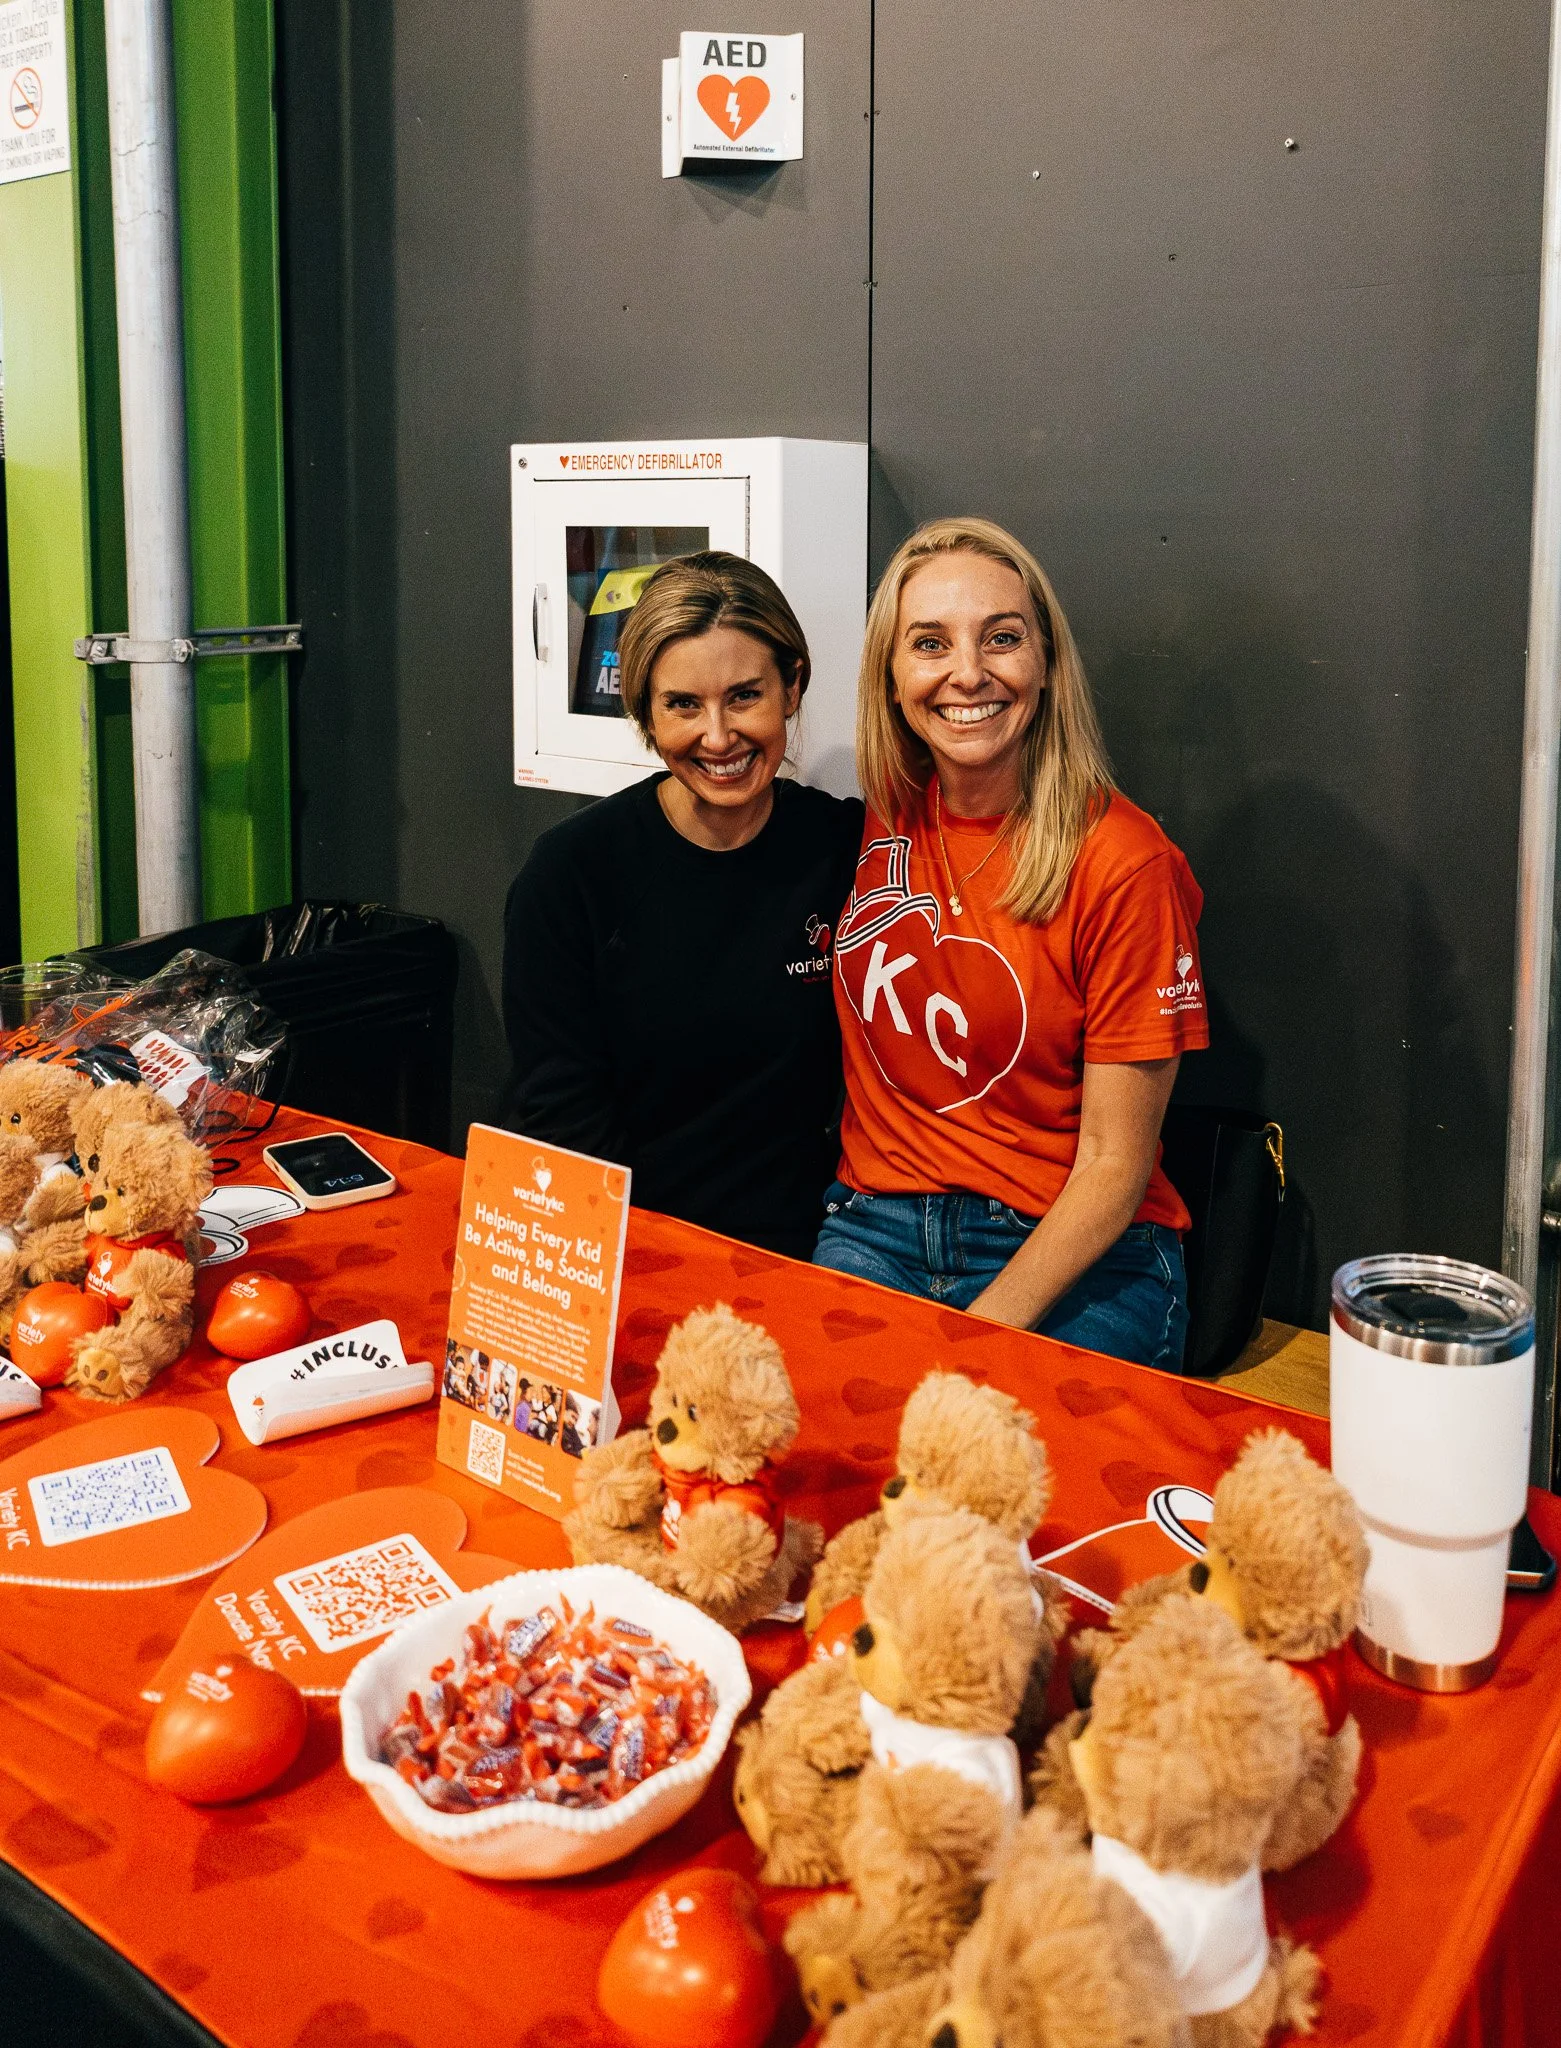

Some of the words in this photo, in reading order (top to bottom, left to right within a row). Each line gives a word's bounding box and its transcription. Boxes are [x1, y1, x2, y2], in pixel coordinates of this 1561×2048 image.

[15, 20, 49, 44] TOBACCO
[16, 41, 53, 65] PROPERTY
[703, 39, 767, 67] AED
[25, 132, 40, 149] YOU
[41, 127, 57, 145] FOR
[744, 145, 776, 153] Defibrillator
[572, 454, 635, 470] EMERGENCY
[638, 453, 722, 470] DEFIBRILLATOR
[786, 954, 832, 977] variet
[513, 1186, 565, 1213] varietykc
[475, 1202, 527, 1243] Helping
[532, 1221, 573, 1258] Every
[576, 1237, 602, 1264] Kid
[465, 1223, 482, 1246] Be
[485, 1231, 531, 1267] Active,
[535, 1249, 554, 1273] Be
[558, 1256, 607, 1296] Social,
[491, 1263, 520, 1285] and
[522, 1269, 572, 1311] Belong
[17, 1321, 46, 1345] variety
[214, 1591, 254, 1642] Donate
[246, 1588, 285, 1637] Variety
[275, 1634, 308, 1662] KC
